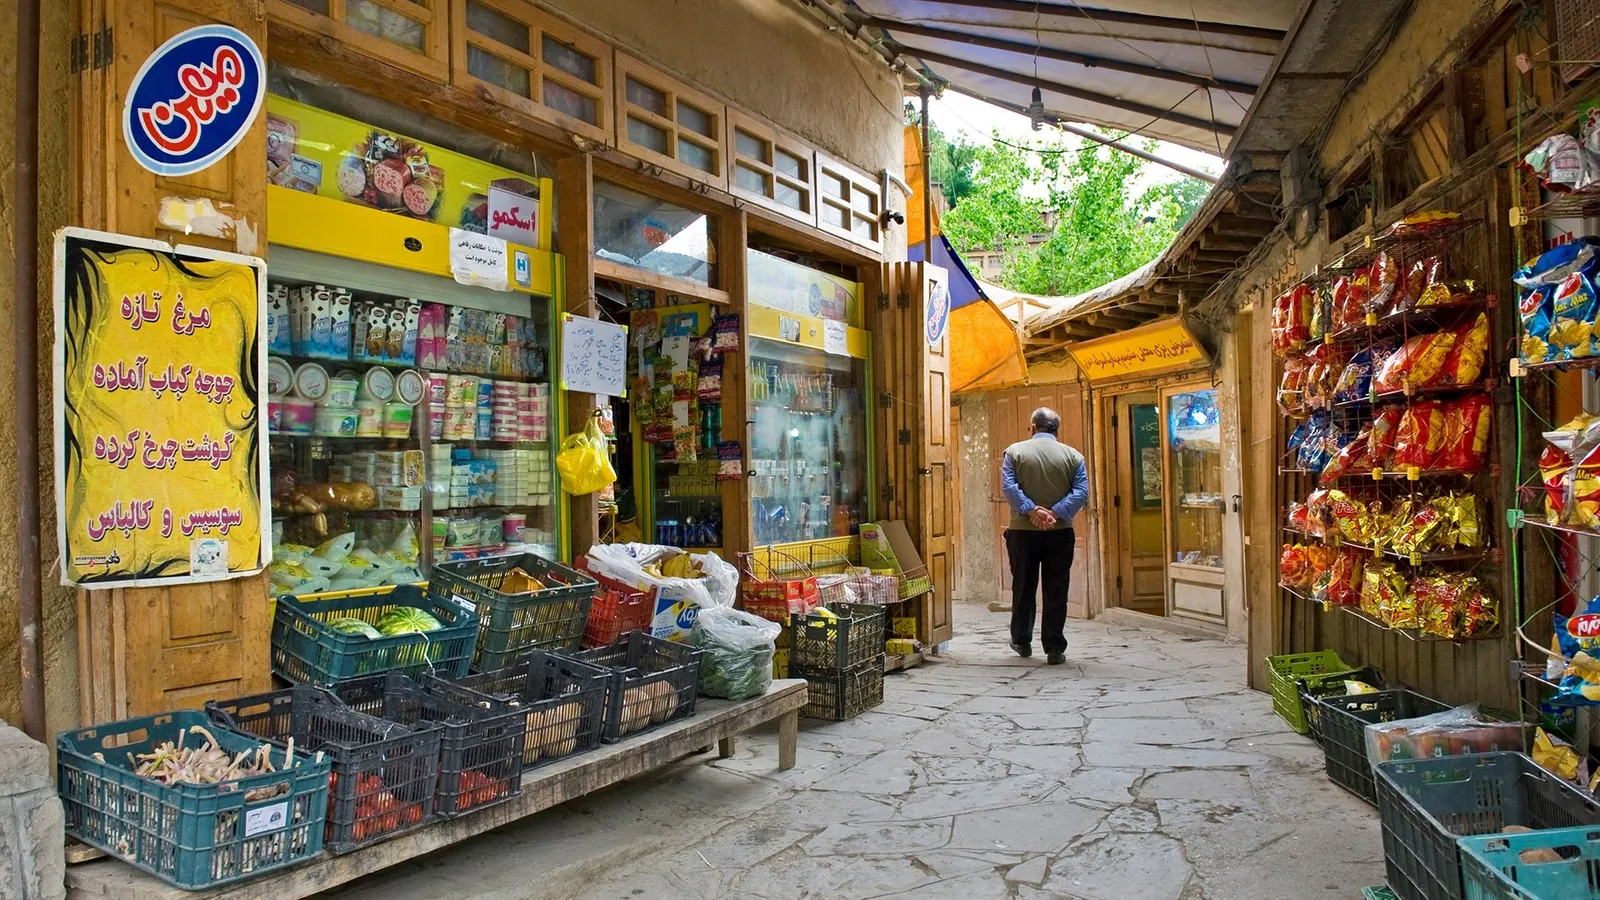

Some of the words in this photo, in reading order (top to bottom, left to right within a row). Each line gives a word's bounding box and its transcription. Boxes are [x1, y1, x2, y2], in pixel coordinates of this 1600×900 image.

[137, 44, 246, 156] میهن
[491, 206, 536, 232] اسکمو
[457, 241, 472, 249] رفاهی
[474, 256, 488, 265] موجود
[487, 258, 498, 266] کامل
[120, 291, 161, 331] تازه
[171, 293, 211, 335] مرغ
[93, 356, 149, 393] آماده
[148, 362, 192, 401] کباب
[194, 372, 236, 403] جوجه
[94, 429, 140, 462] کرده
[142, 430, 179, 470] چرخ
[181, 431, 235, 470] گوشت
[87, 498, 153, 541] کالباس
[161, 506, 173, 538] و
[180, 504, 242, 537] سوسیس
